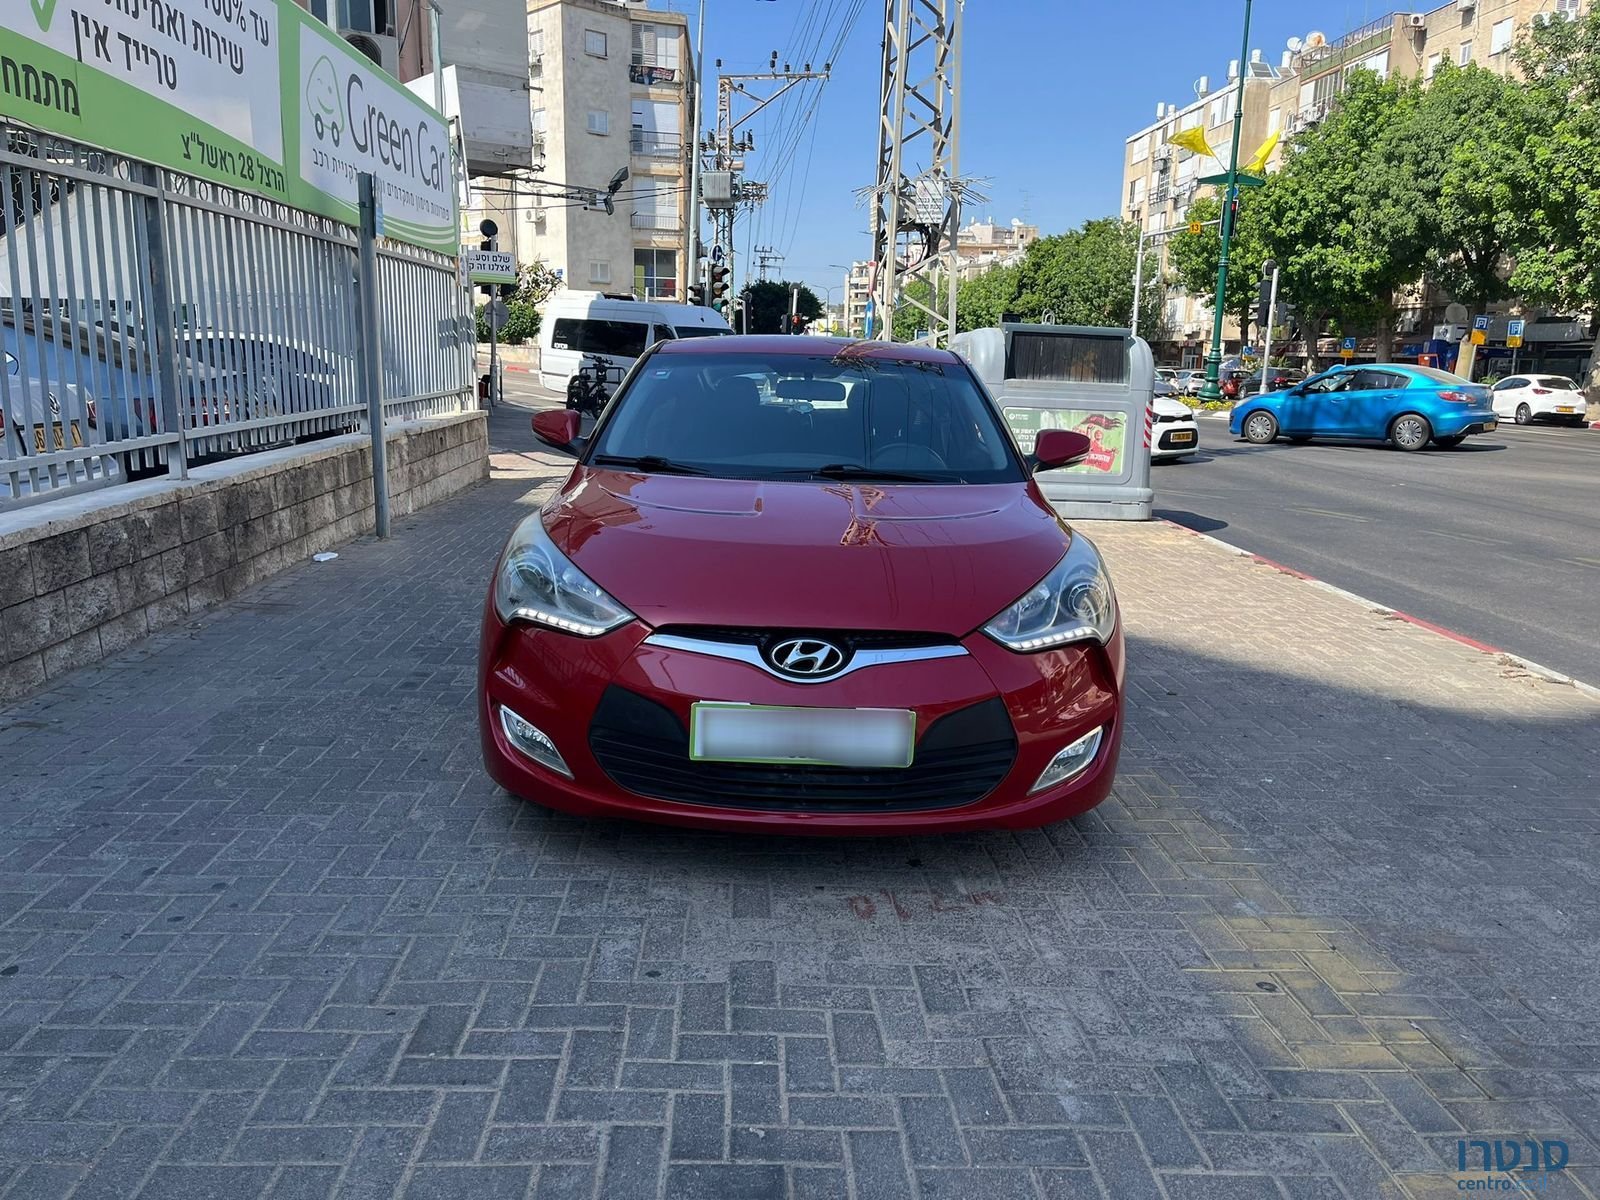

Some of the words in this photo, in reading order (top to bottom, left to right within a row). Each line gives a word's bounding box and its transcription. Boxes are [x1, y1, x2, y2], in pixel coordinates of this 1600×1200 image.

[71, 9, 111, 63] אין
[250, 9, 269, 46] עד
[117, 31, 177, 90] טרייד
[192, 19, 244, 75] שירות
[347, 73, 415, 178] Green
[418, 121, 445, 193] Car
[238, 152, 255, 182] 28
[257, 157, 285, 193] הרצל
[313, 148, 330, 170] רכב
[1191, 224, 1200, 232] 13
[477, 263, 486, 271] זה
[488, 263, 511, 272] אצלנו
[492, 254, 511, 263] שלם
